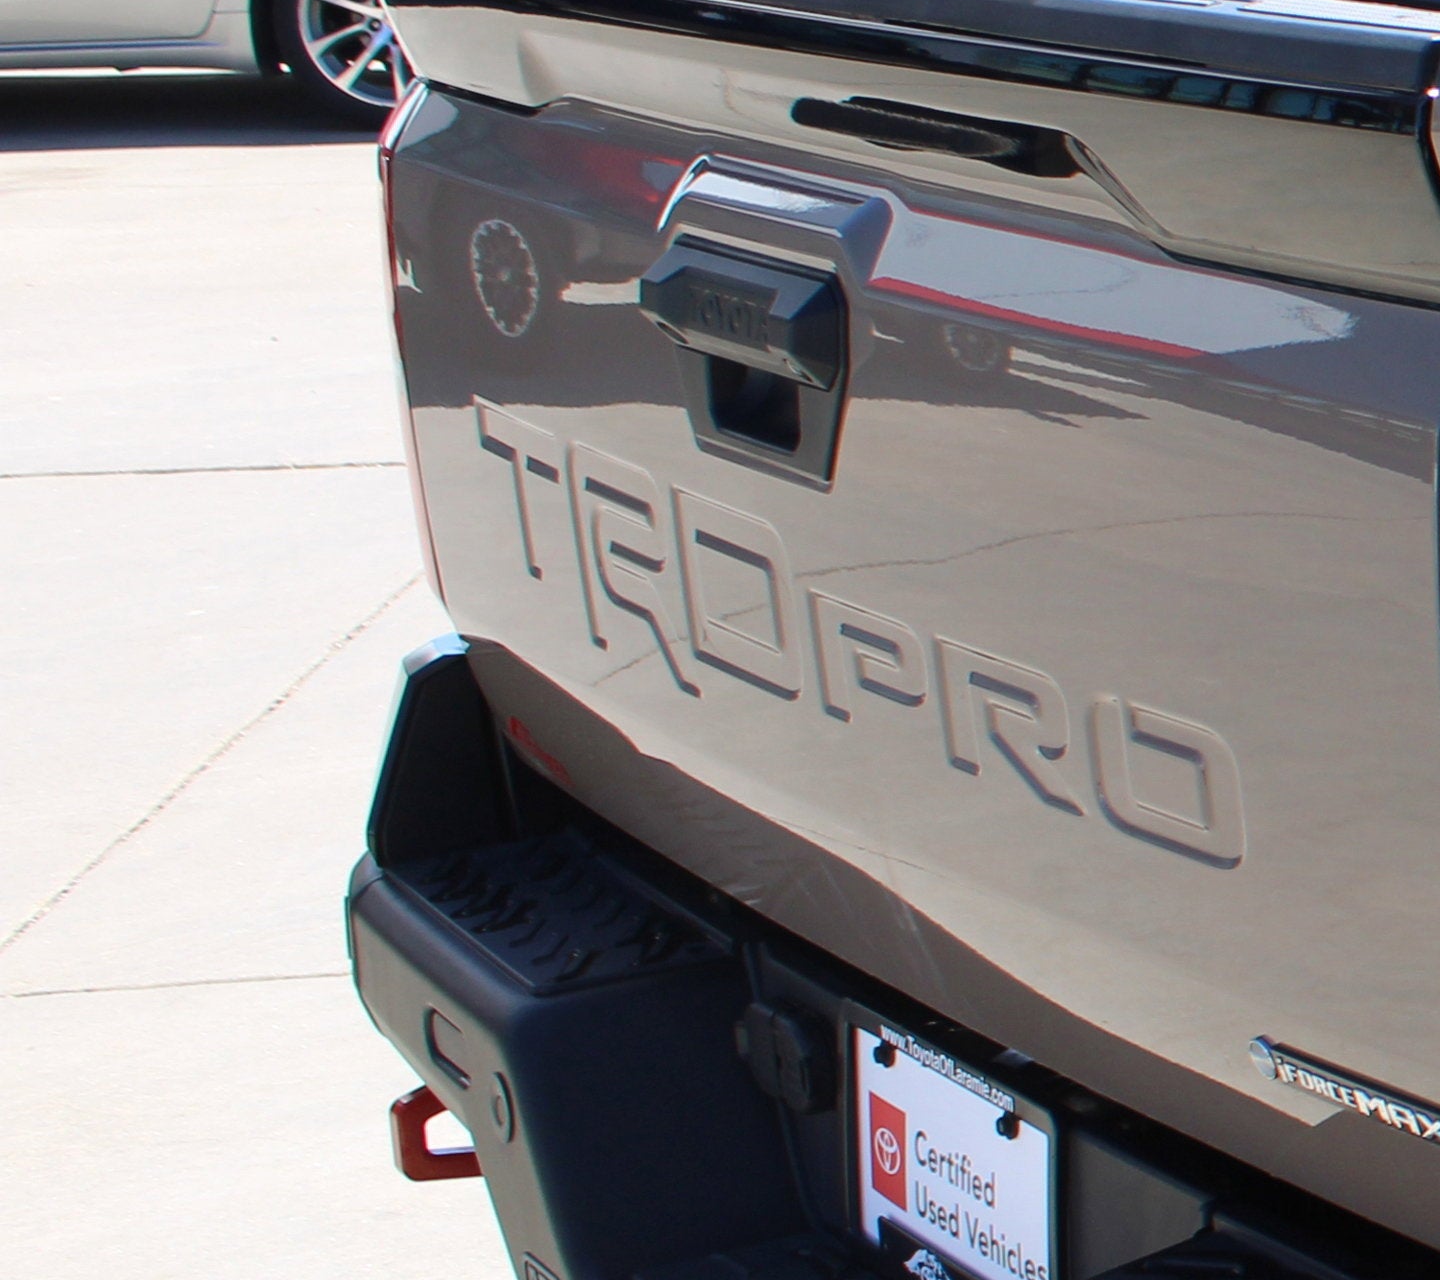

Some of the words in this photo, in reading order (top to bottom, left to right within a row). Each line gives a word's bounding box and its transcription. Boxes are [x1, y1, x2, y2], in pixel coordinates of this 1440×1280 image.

[472, 393, 802, 701] TRD
[807, 586, 1248, 870] PRO
[914, 1129, 997, 1210] Certified
[914, 1179, 960, 1240] Used
